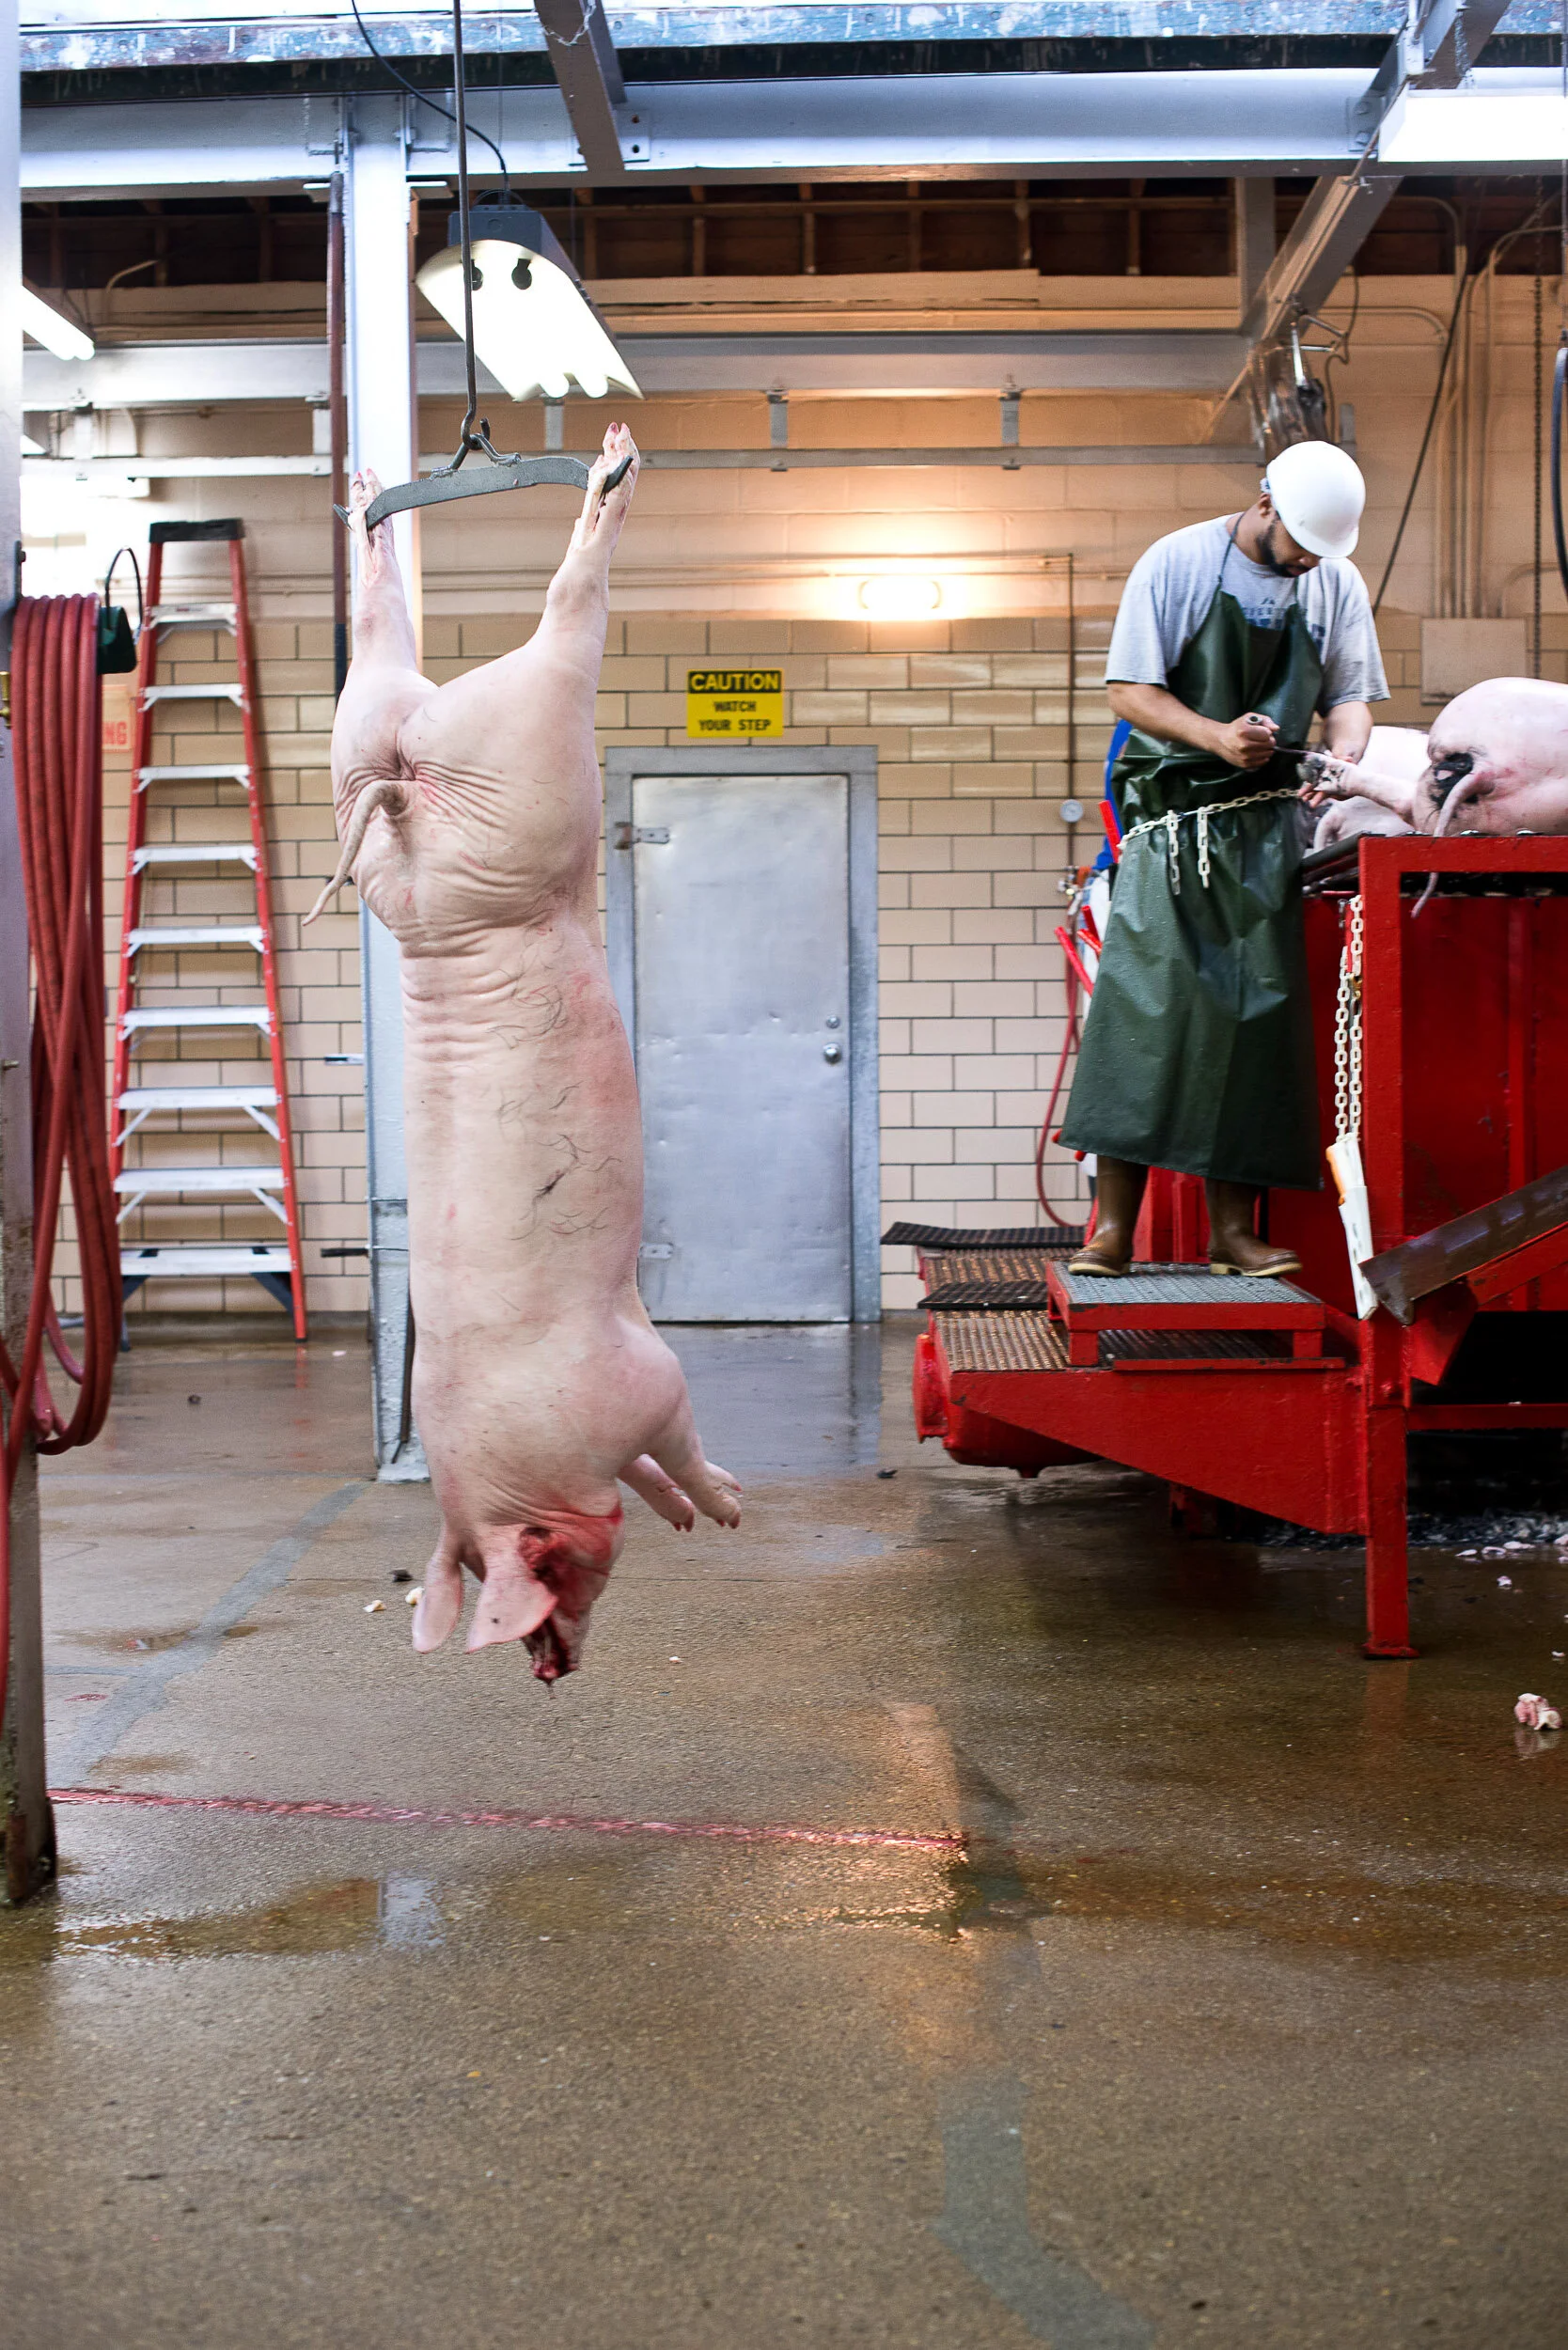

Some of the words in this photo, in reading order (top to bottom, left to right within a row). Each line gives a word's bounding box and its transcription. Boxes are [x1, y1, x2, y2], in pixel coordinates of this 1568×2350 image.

[691, 673, 779, 691] CAUTION
[713, 700, 757, 712] WATCH
[698, 719, 731, 730] YOUR
[738, 719, 771, 730] STEP
